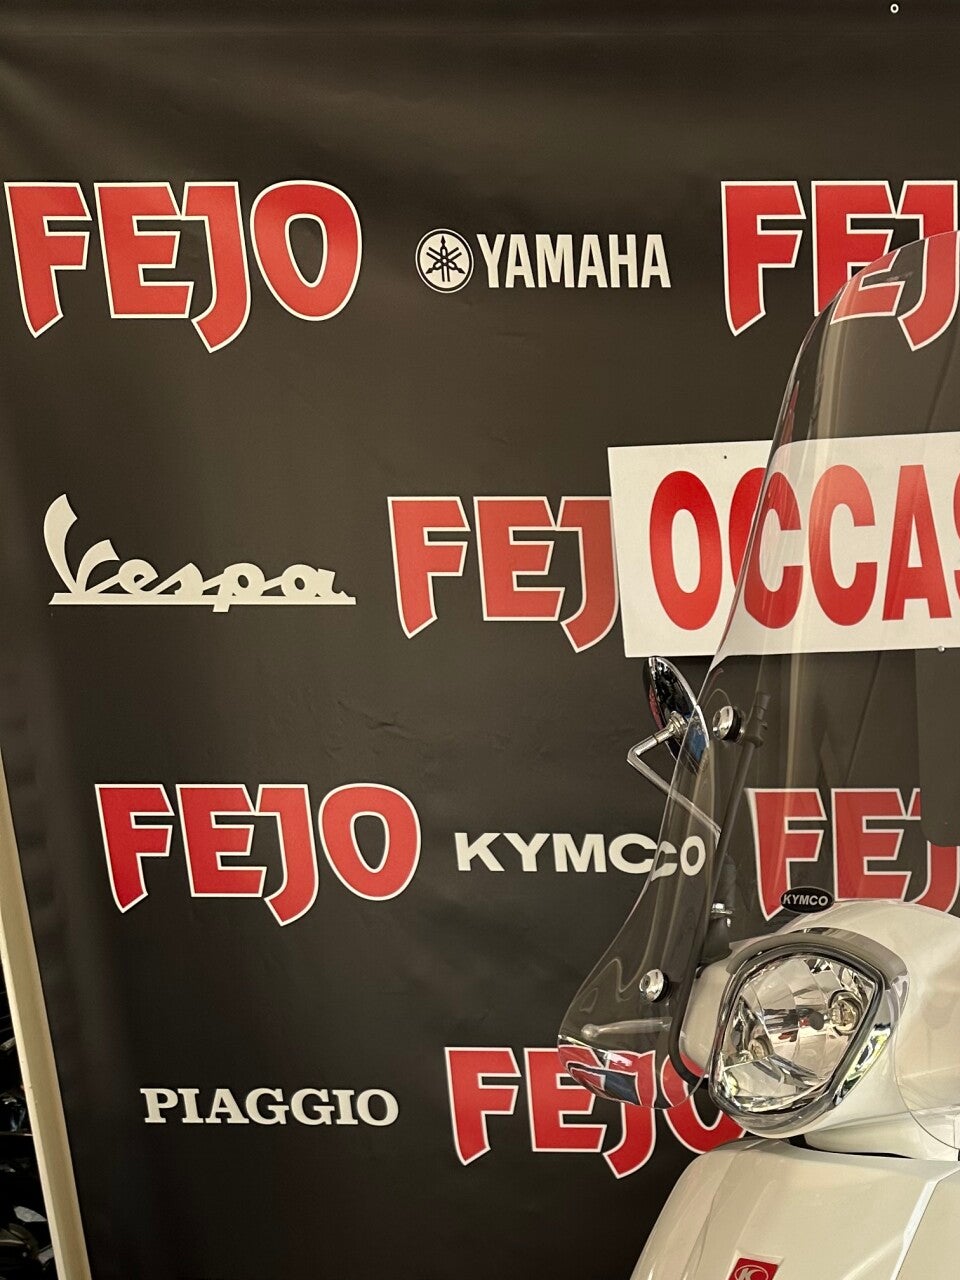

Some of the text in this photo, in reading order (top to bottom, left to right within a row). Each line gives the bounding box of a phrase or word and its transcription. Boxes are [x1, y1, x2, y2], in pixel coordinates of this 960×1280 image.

[4, 180, 362, 353] FEJO
[476, 233, 671, 288] YAMAHA
[43, 493, 357, 612] Vespa
[387, 495, 621, 653] FEJ
[94, 783, 421, 926] FEJO
[454, 832, 706, 876] KYMCO
[782, 893, 829, 907] KYMCO
[140, 1088, 399, 1127] PIAGGIO
